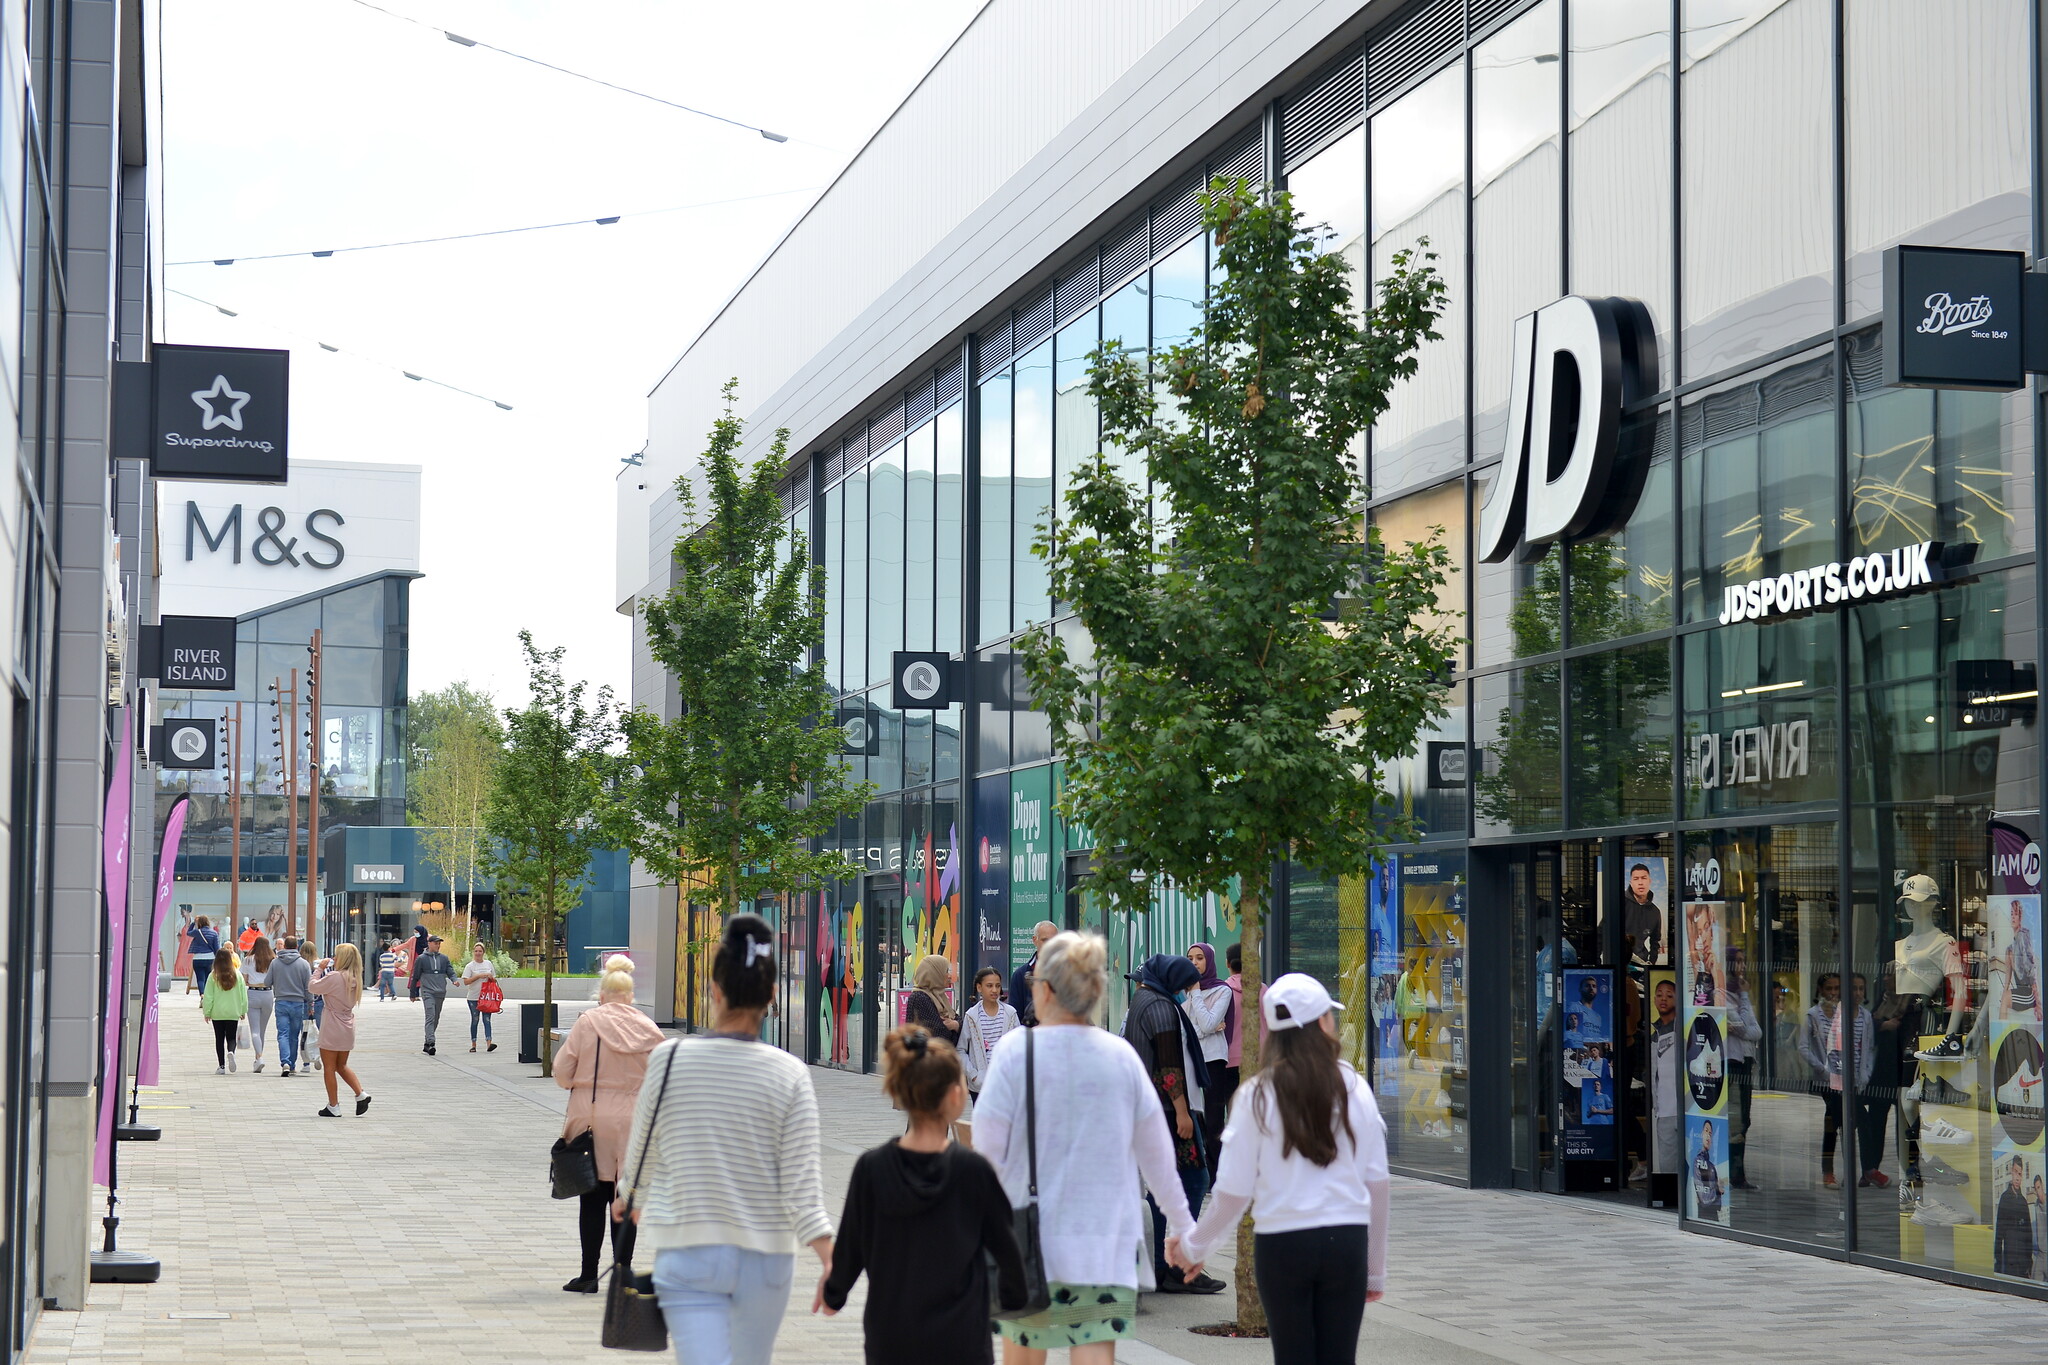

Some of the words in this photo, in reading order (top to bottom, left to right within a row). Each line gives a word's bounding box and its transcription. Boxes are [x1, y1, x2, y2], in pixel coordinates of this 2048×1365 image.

[1916, 292, 1993, 335] Boots
[1971, 330, 1990, 339] Since
[1991, 330, 2008, 340] 1849
[165, 432, 275, 453] Superdrug
[1480, 295, 1618, 563] JD
[185, 500, 345, 570] M&S
[1718, 540, 1933, 626] JDSPORTS.CO.UK
[173, 648, 220, 665] RIVER
[166, 665, 227, 682] ISLAND
[1013, 789, 1041, 841] Dippy
[1013, 853, 1025, 883] on
[1026, 843, 1048, 881] Tour
[1998, 854, 2020, 876] AM
[480, 991, 500, 1000] SALE
